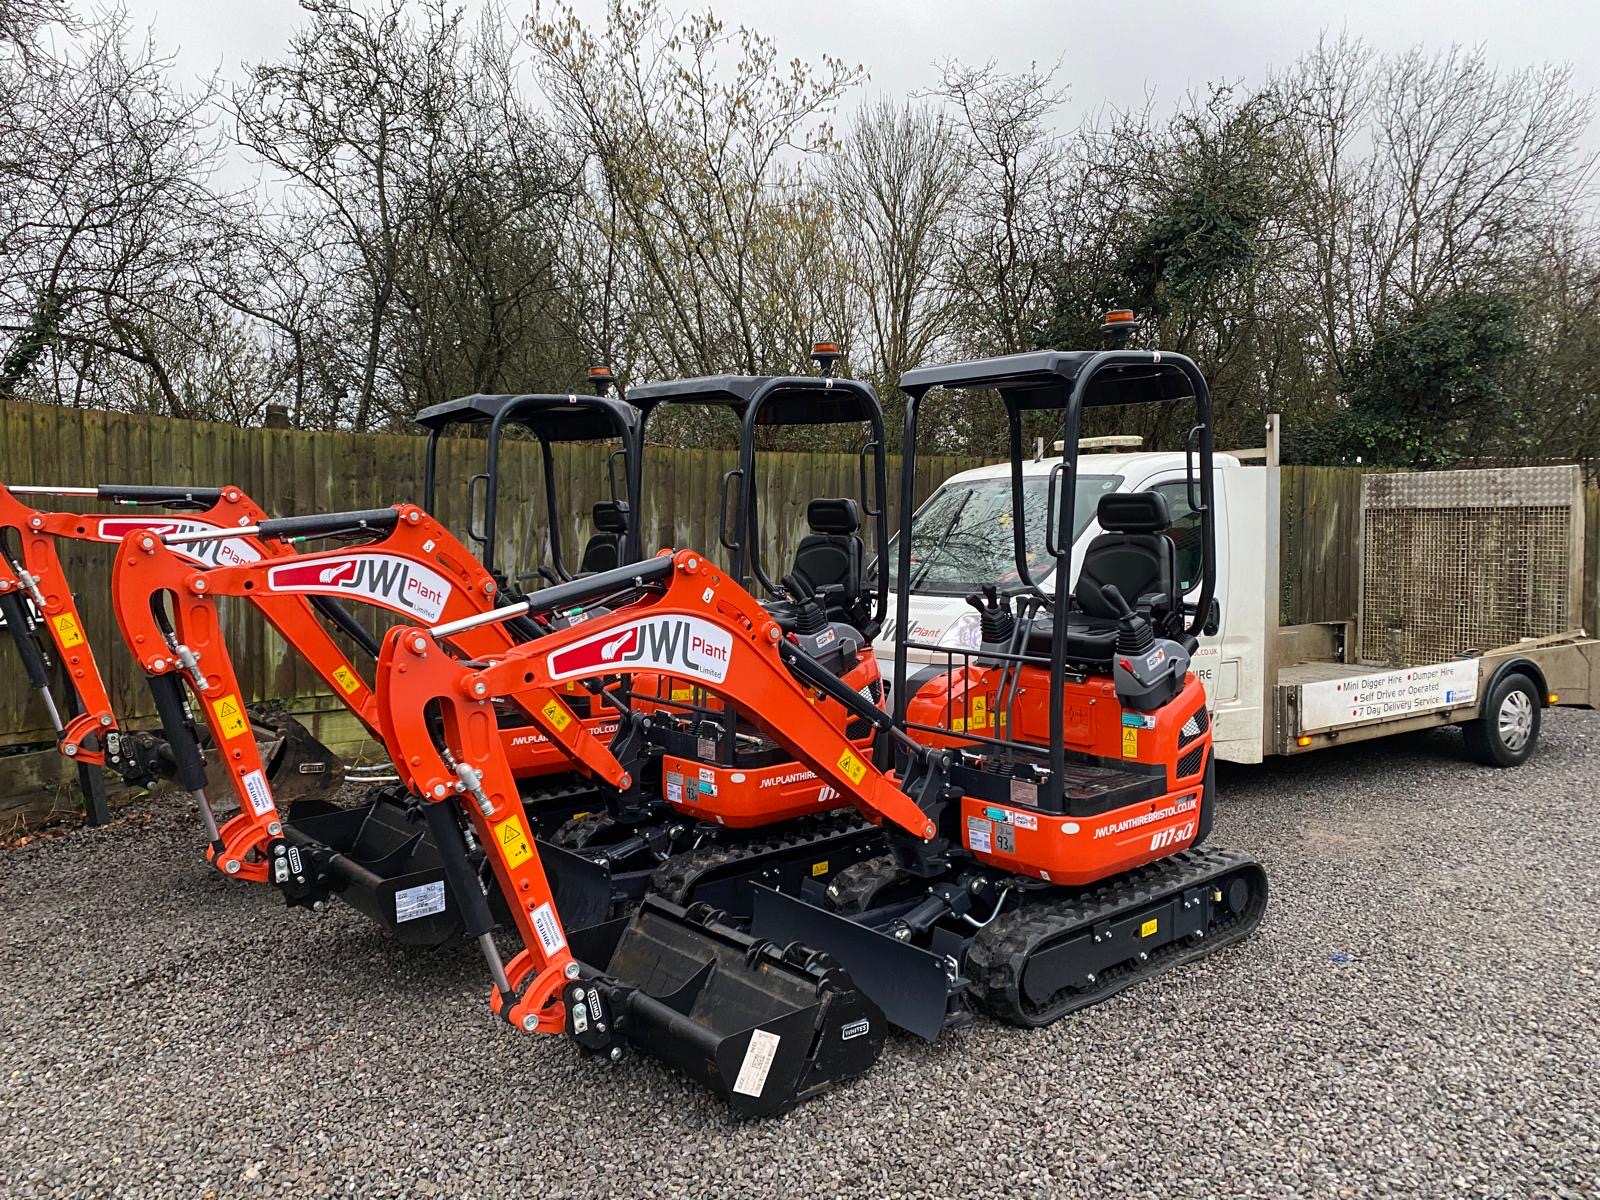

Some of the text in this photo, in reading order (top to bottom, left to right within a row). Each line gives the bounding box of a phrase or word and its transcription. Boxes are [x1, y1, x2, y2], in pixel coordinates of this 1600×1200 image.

[341, 559, 442, 608] JWL Plant
[413, 603, 435, 619] Limited
[911, 627, 940, 638] Plant
[623, 620, 727, 671] JWL Plant
[699, 665, 721, 680] Limited
[1343, 667, 1454, 692] Mini Digger Hire Dumper Hire
[1359, 683, 1439, 703] Self Drive or Operated
[1358, 696, 1440, 717] 7 Day Delivery Service
[997, 835, 1008, 850] 93
[536, 917, 551, 948] WHITES
[845, 1024, 867, 1037] WHITES
